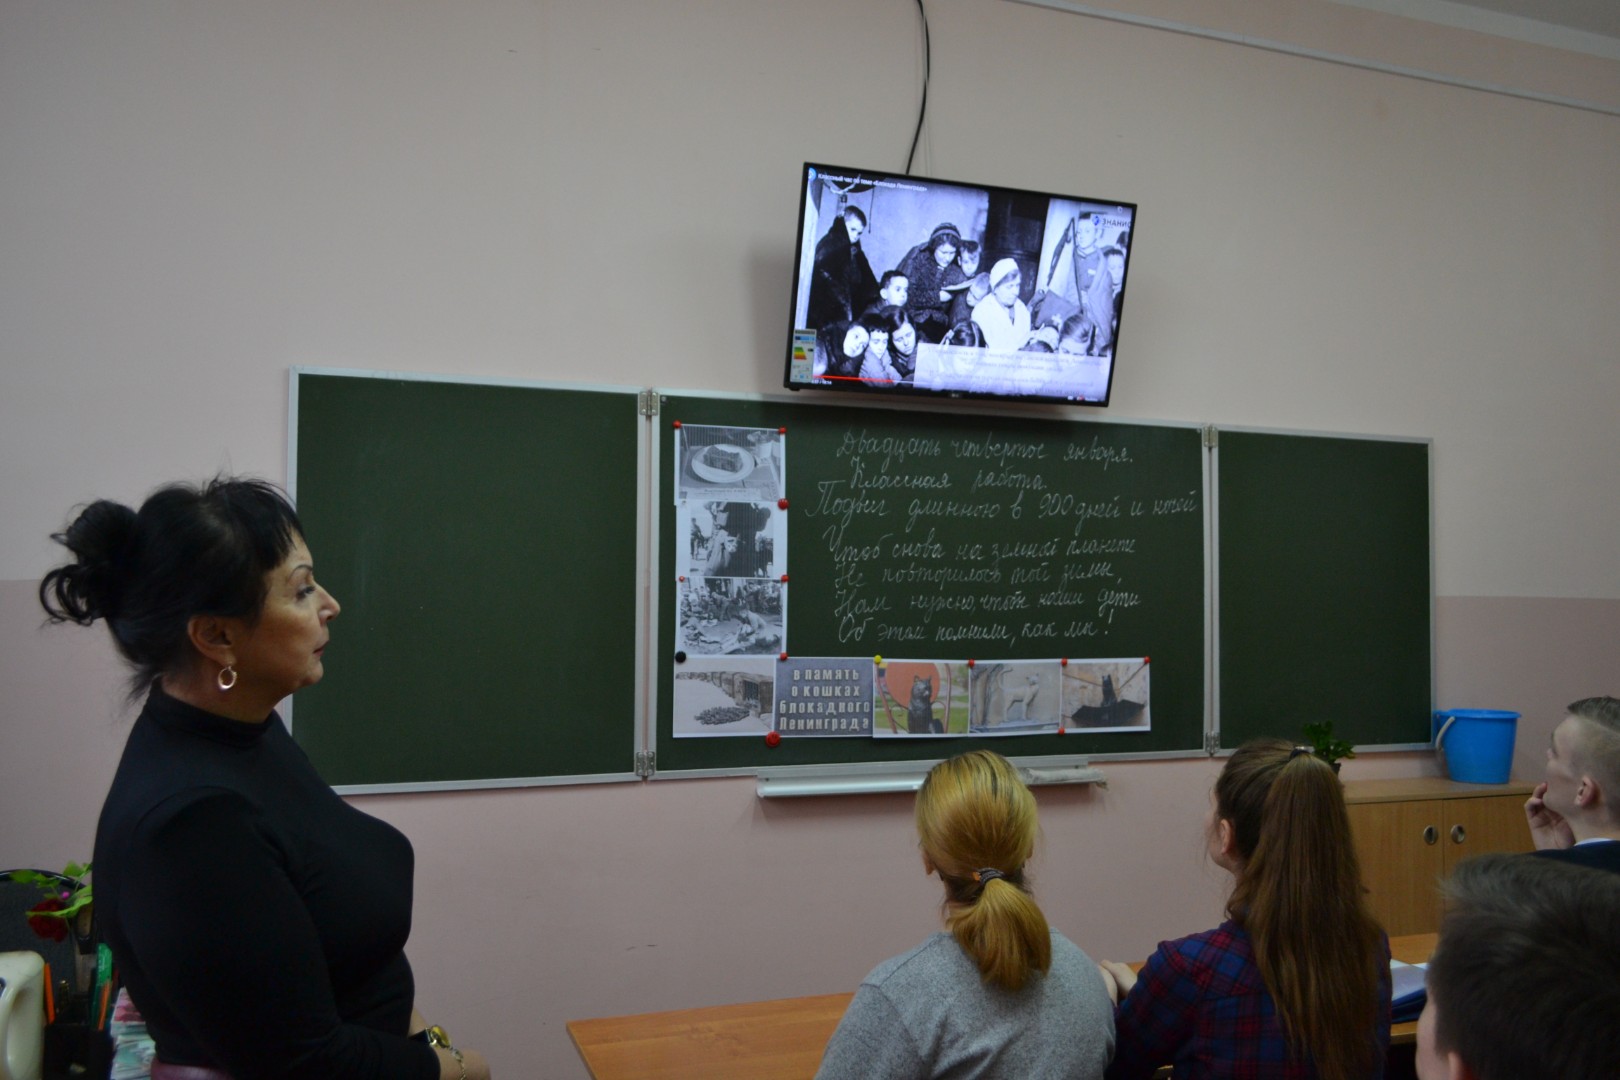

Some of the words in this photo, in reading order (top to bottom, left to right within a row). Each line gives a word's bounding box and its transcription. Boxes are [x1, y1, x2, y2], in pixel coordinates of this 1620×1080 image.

[837, 429, 942, 473] Двадцать
[951, 432, 1048, 467] четвертое
[850, 456, 952, 489] Классная
[805, 480, 890, 528] Подвиг
[906, 498, 1000, 533] длинною
[1010, 490, 1024, 519] в
[1038, 493, 1073, 519] 900
[1075, 495, 1121, 537] дней
[1131, 500, 1145, 516] и
[822, 525, 894, 562] Чтоб
[892, 527, 946, 559] снова
[955, 543, 984, 560] на
[992, 537, 1061, 565] земной
[1066, 538, 1136, 556] планете
[834, 562, 867, 588] Не
[882, 562, 1001, 590] повторилось
[1011, 562, 1052, 585] той
[834, 589, 892, 617] Нам
[1037, 591, 1084, 608] наши
[1098, 588, 1142, 617] дети
[838, 613, 874, 643] Об
[877, 623, 925, 642] этом
[1022, 621, 1058, 638] как
[779, 700, 871, 716] блокадного
[779, 717, 870, 732] Ленинграда
